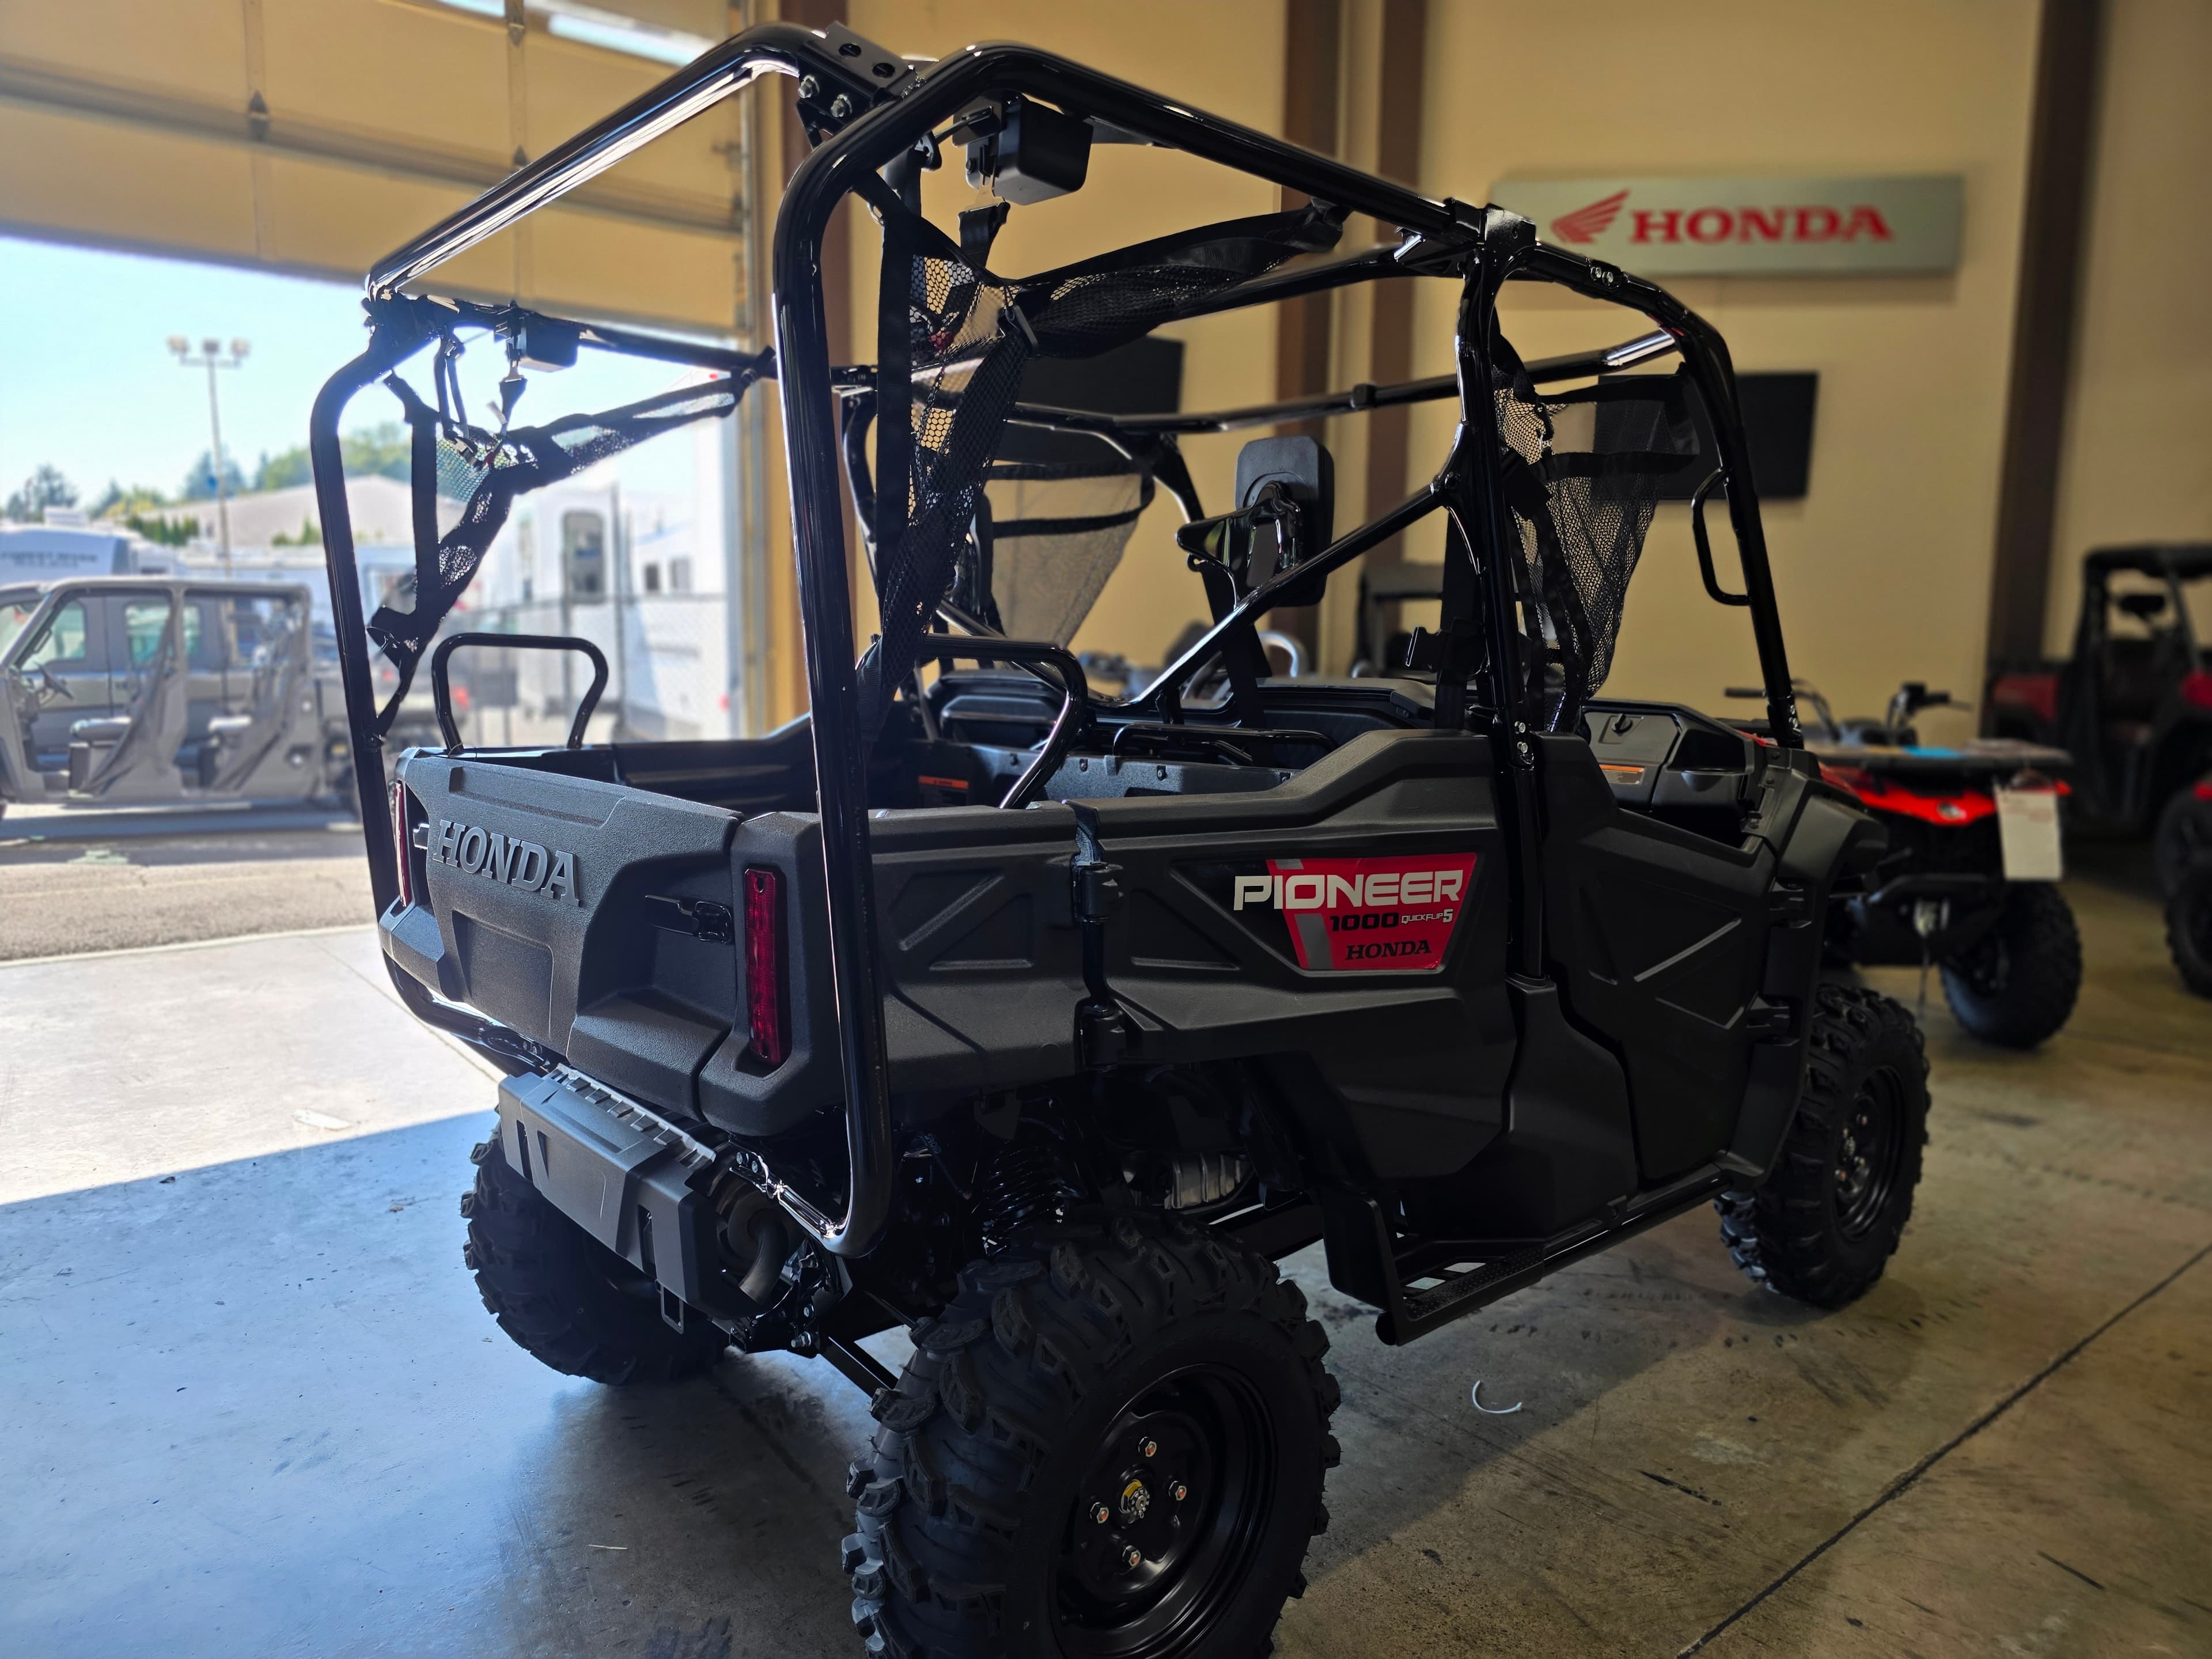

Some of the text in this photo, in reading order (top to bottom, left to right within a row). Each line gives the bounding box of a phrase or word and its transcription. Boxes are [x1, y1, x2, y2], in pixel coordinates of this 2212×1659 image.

[1630, 204, 1896, 244] HONDA
[433, 819, 579, 907] HONDA
[1233, 870, 1463, 911] PIONEER
[1330, 912, 1399, 931] 1000
[1346, 940, 1431, 960] HONDA
